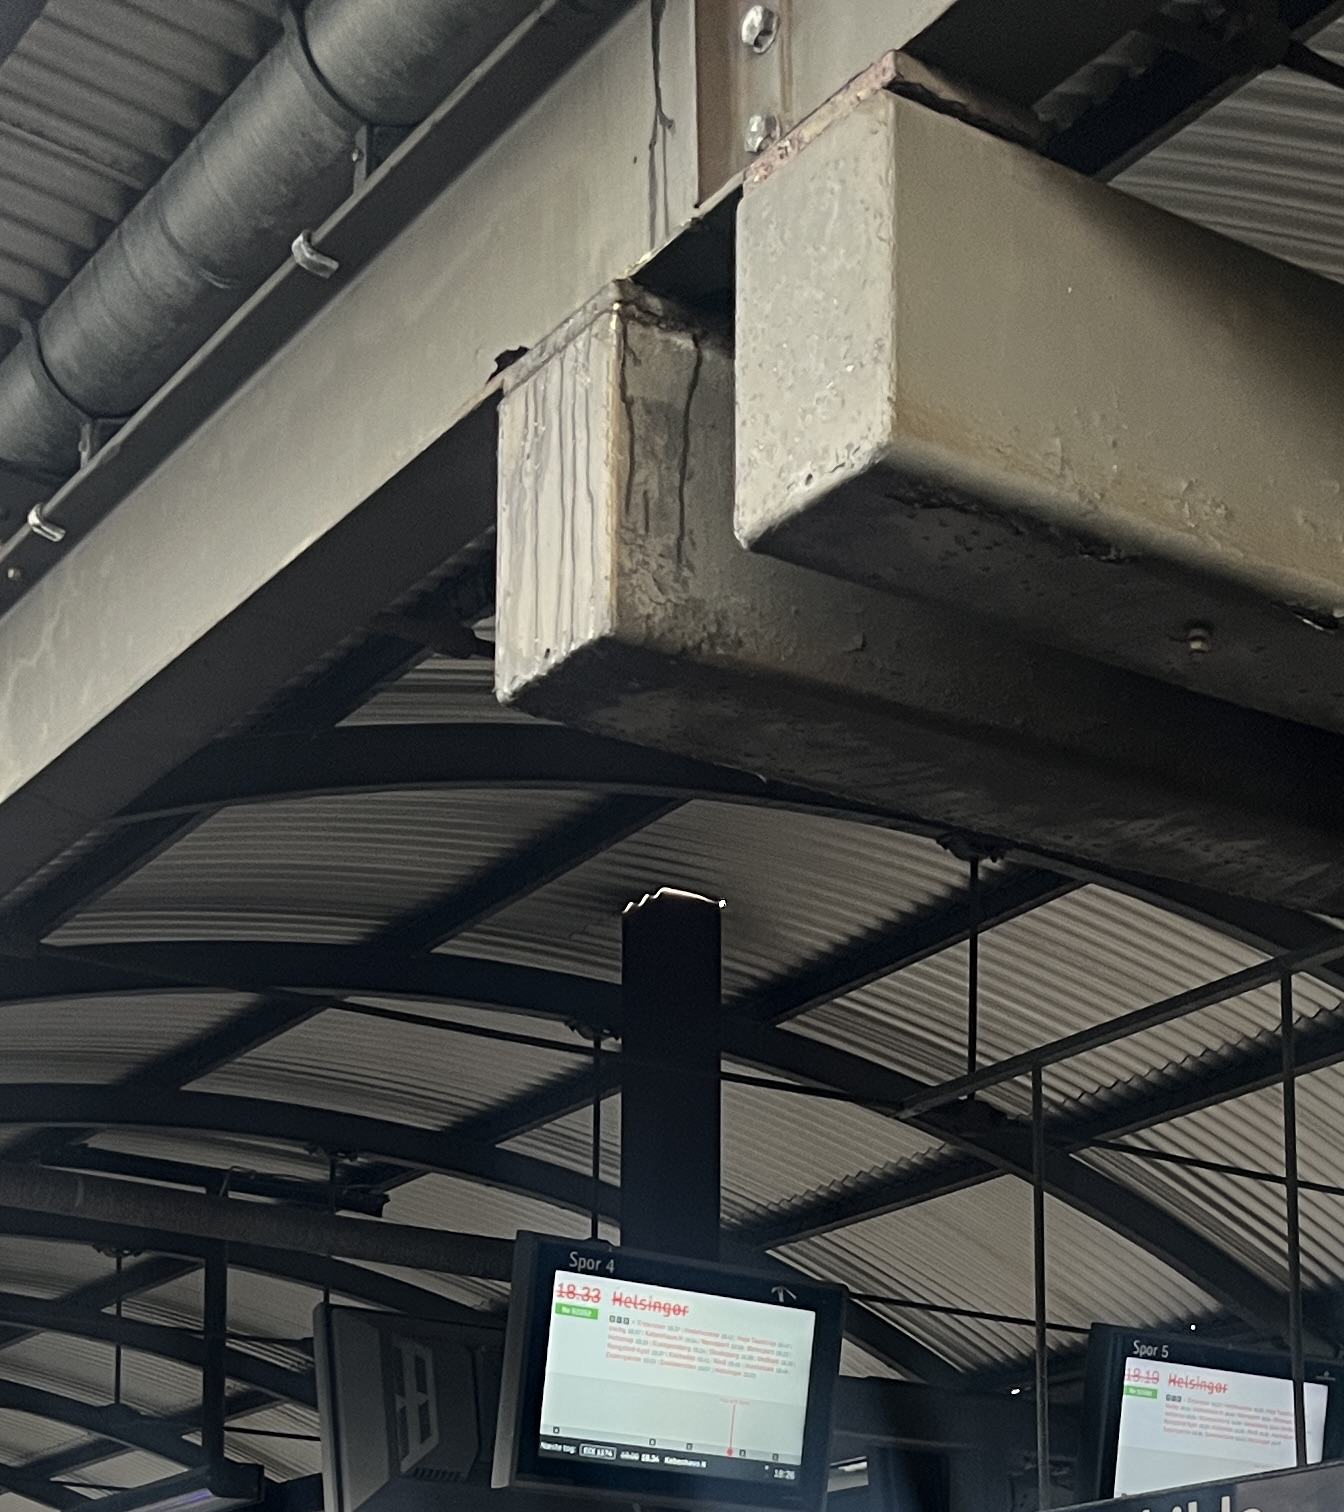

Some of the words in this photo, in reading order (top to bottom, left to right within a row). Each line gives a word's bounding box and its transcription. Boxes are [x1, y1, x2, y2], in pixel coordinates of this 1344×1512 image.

[569, 1251, 602, 1272] Spor
[606, 1258, 615, 1274] 4
[1133, 1339, 1158, 1357] Spor
[1161, 1344, 1169, 1358] 5
